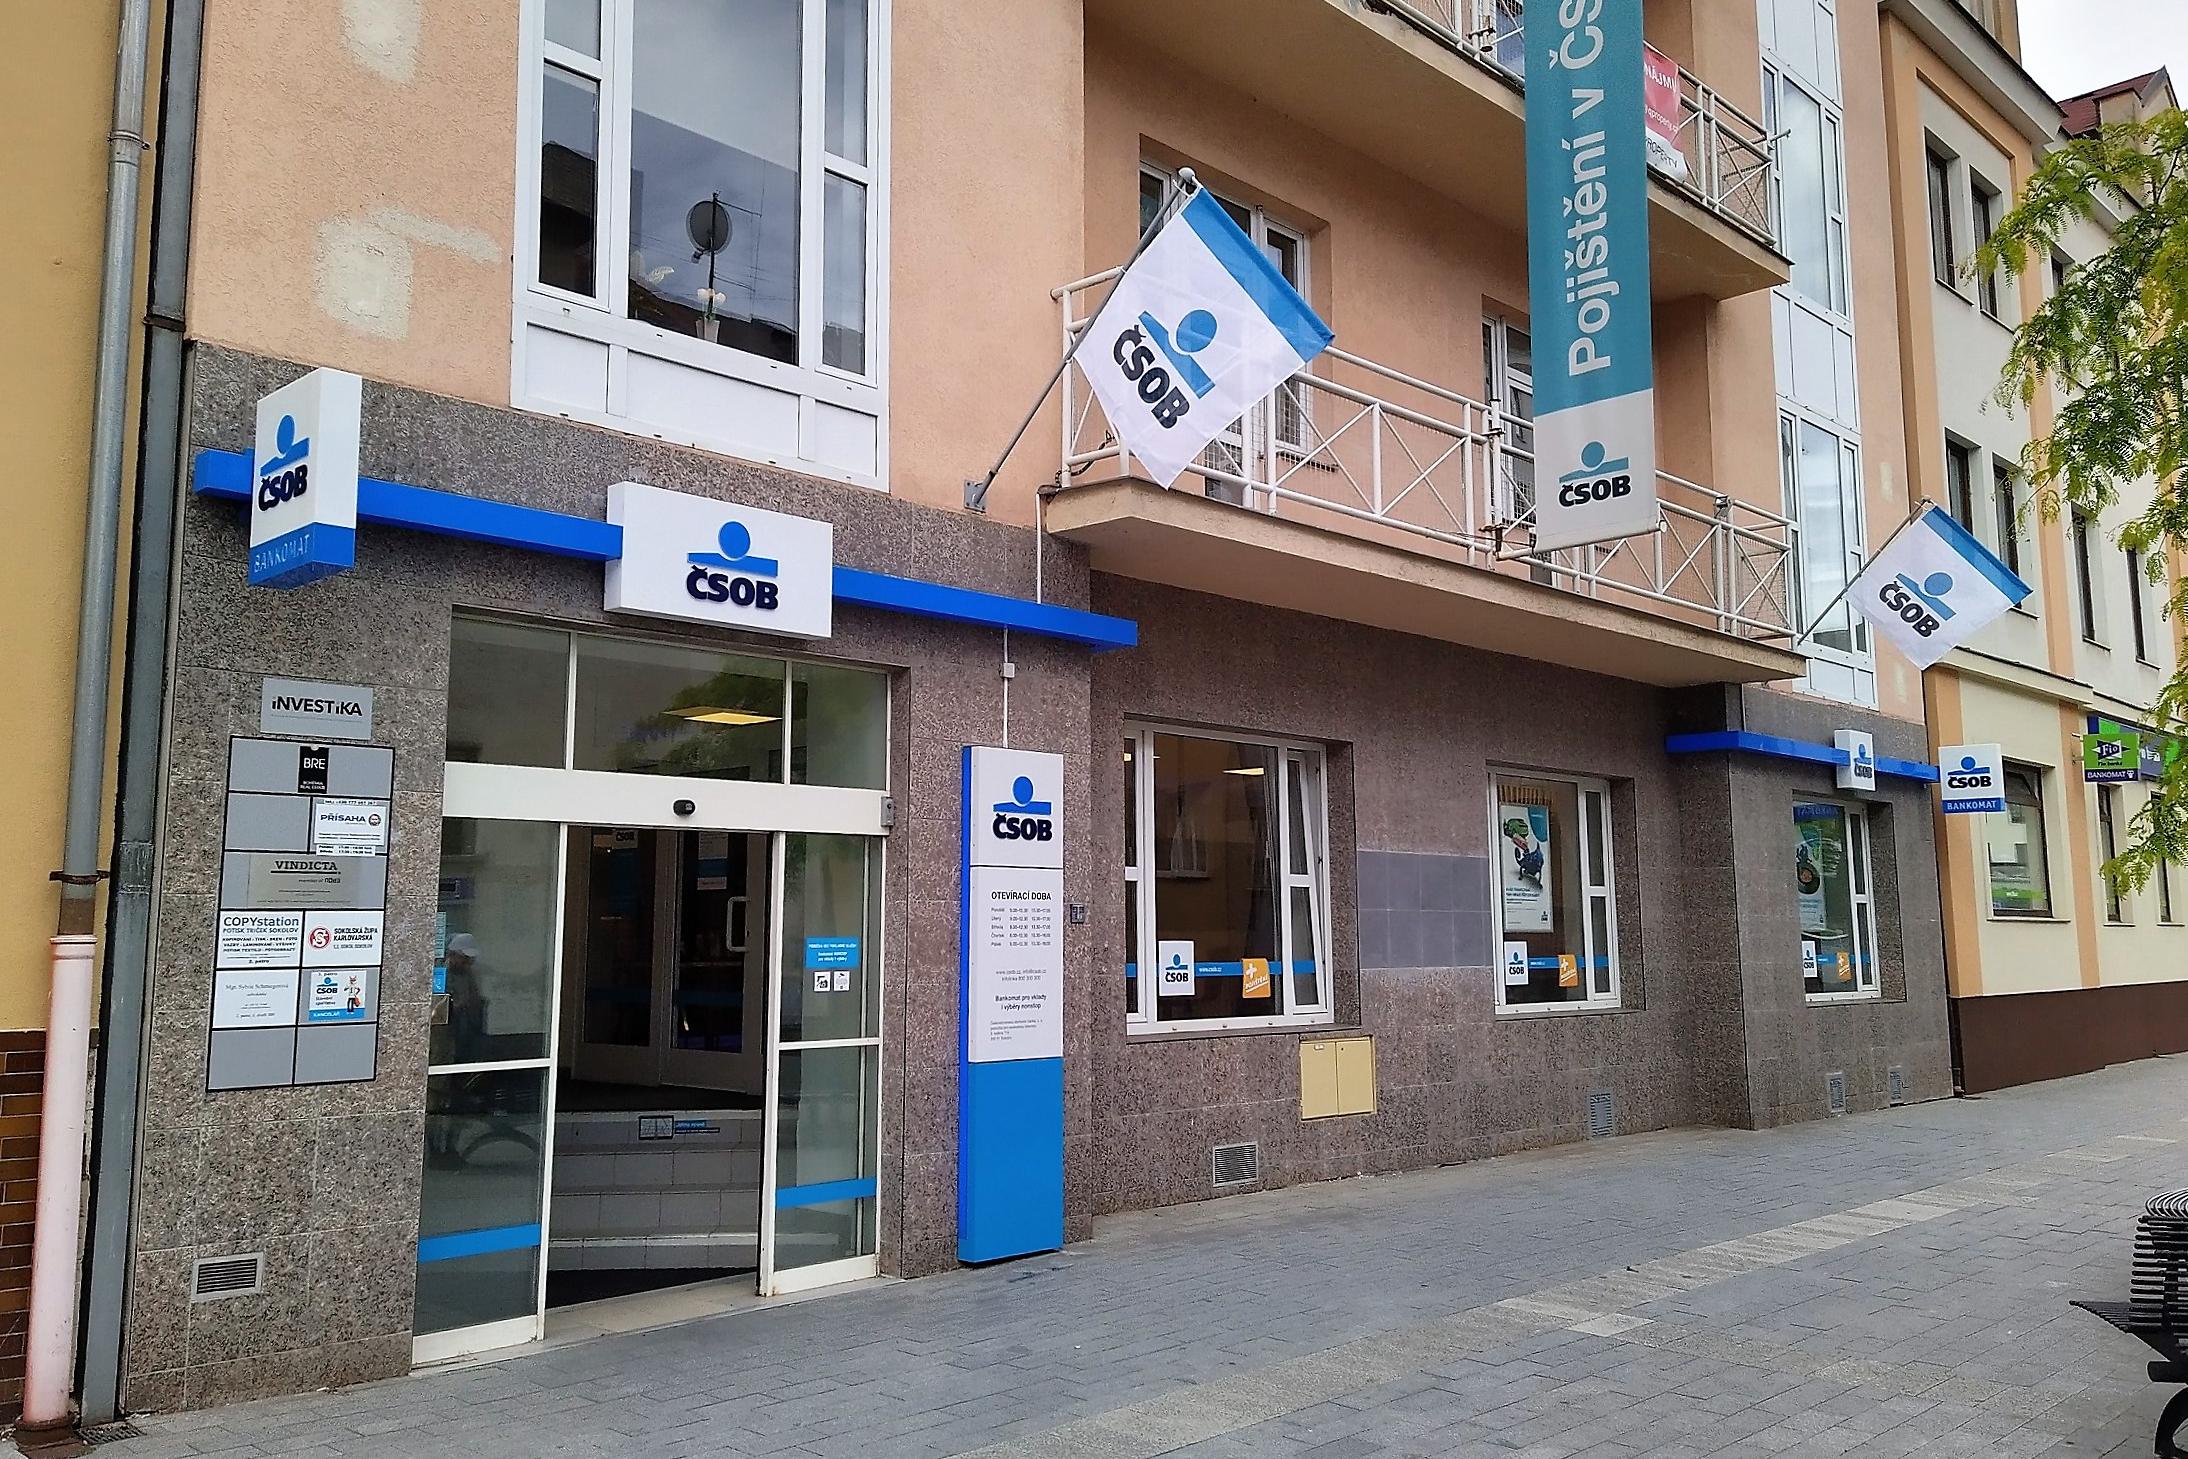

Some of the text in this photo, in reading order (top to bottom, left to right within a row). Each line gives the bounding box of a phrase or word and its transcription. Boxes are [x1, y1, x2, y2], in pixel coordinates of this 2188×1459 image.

[1571, 88, 1605, 120] v
[1646, 137, 1678, 168] ROPERTY
[1562, 130, 1620, 377] Pojištění
[1113, 324, 1191, 429] ČSOB
[258, 464, 308, 512] ČSOB
[1559, 474, 1631, 508] ČSOB
[253, 534, 311, 574] BANKOMAT
[686, 565, 779, 610] ČSOB
[1878, 580, 1940, 638] ČSOB
[2101, 744, 2118, 756] Fio
[303, 757, 326, 770] BRE
[2087, 770, 2127, 779] BANKOMAT
[1947, 774, 1993, 789] ČSOB
[1947, 800, 1997, 811] BANKOMAT
[320, 812, 367, 823] PŘÍSAHA
[992, 813, 1053, 842] ČSOB
[275, 861, 338, 871] VINDICTA
[991, 889, 1052, 900] OTEVÍRACÍ DOBA
[223, 916, 299, 927] COPYstation
[1165, 972, 1189, 983] ČSOB
